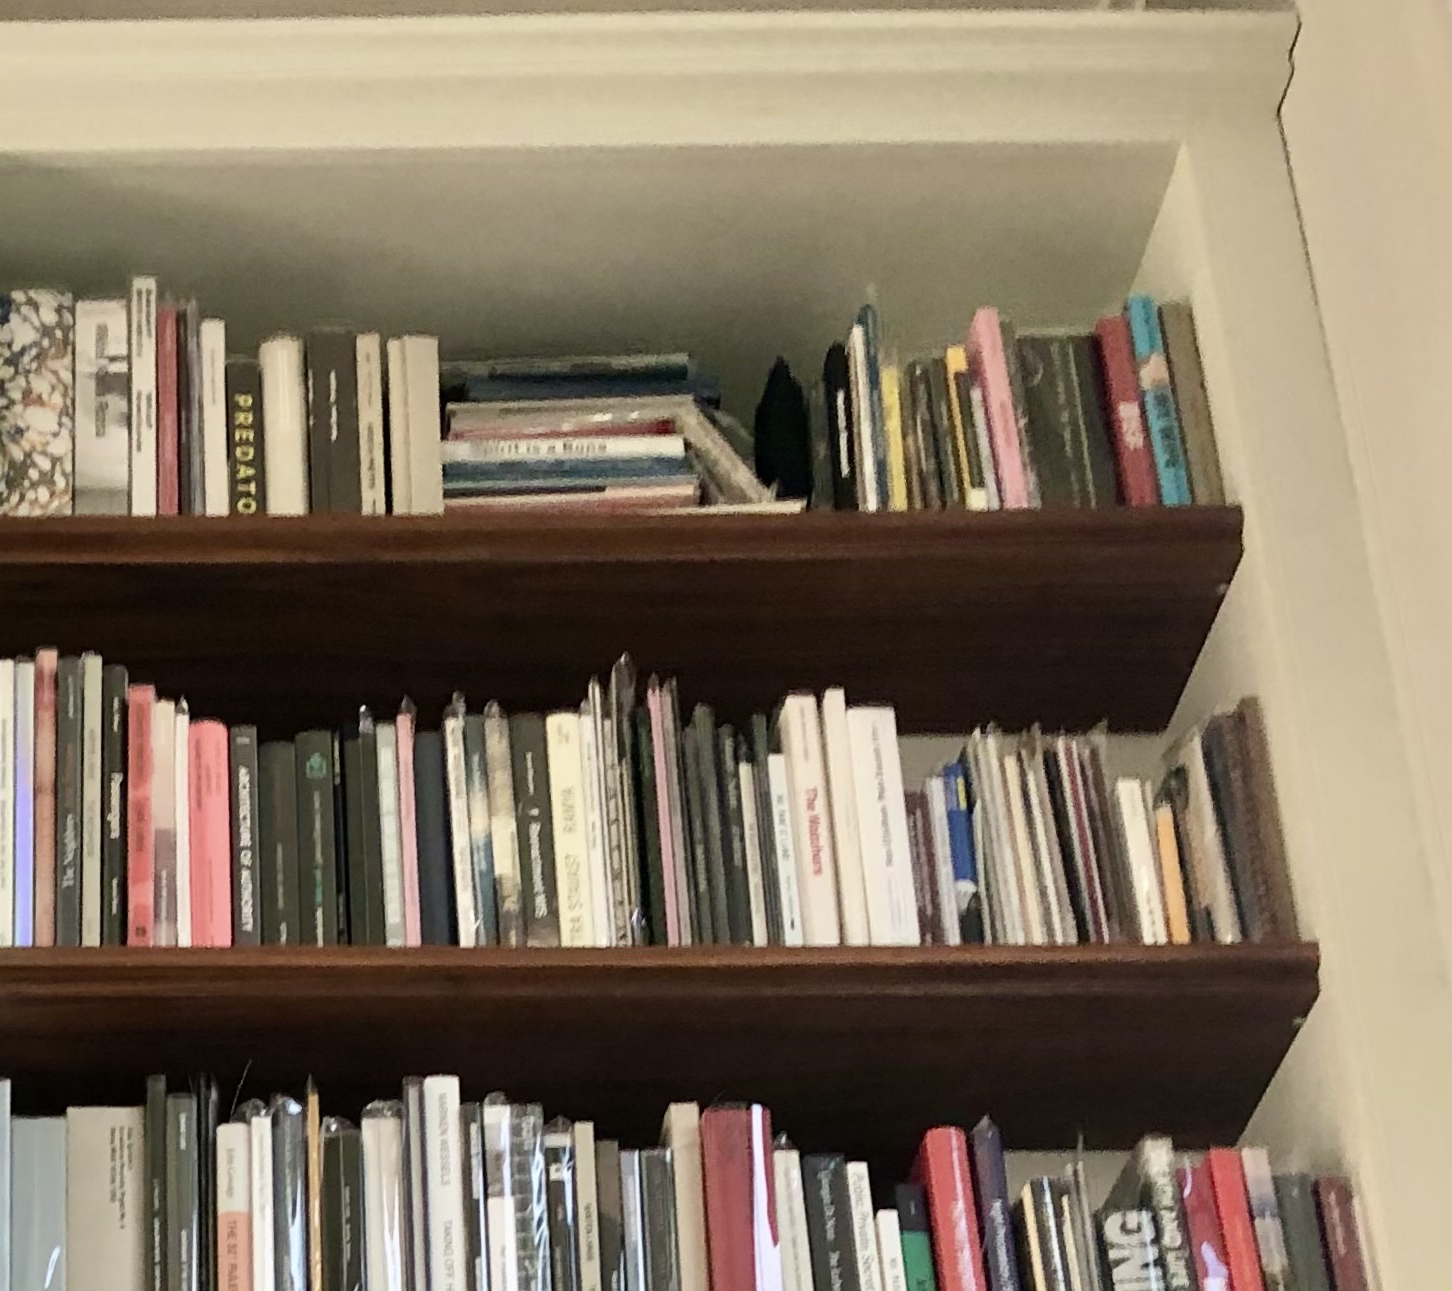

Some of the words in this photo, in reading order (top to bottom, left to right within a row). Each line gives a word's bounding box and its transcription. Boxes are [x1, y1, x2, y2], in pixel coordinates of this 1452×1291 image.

[238, 767, 252, 847] ARCHITECTURE
[240, 850, 252, 867] OF
[240, 867, 253, 932] AUTHORITY
